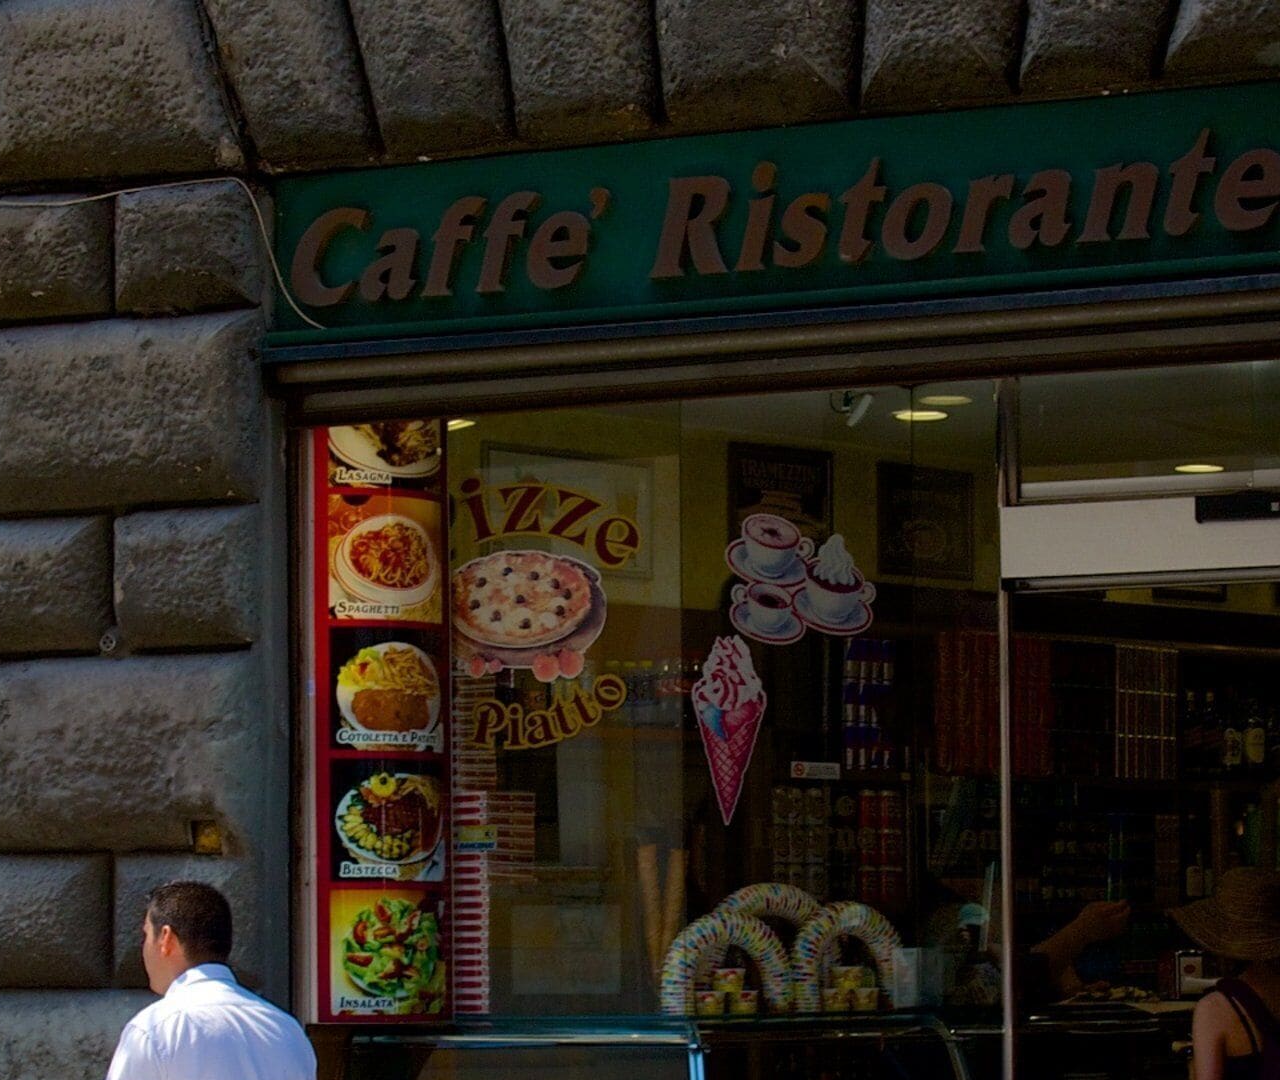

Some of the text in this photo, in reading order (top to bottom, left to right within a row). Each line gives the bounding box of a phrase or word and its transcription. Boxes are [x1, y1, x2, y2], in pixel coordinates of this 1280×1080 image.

[290, 187, 611, 308] Caffe'
[338, 469, 391, 482] LASAGNA
[451, 476, 640, 568] izze
[337, 601, 400, 614] SPAGHETTI
[468, 674, 628, 749] Piatto
[339, 730, 399, 743] COTOLETTA
[341, 864, 399, 876] BISTECCA
[340, 996, 394, 1009] INSALATA
